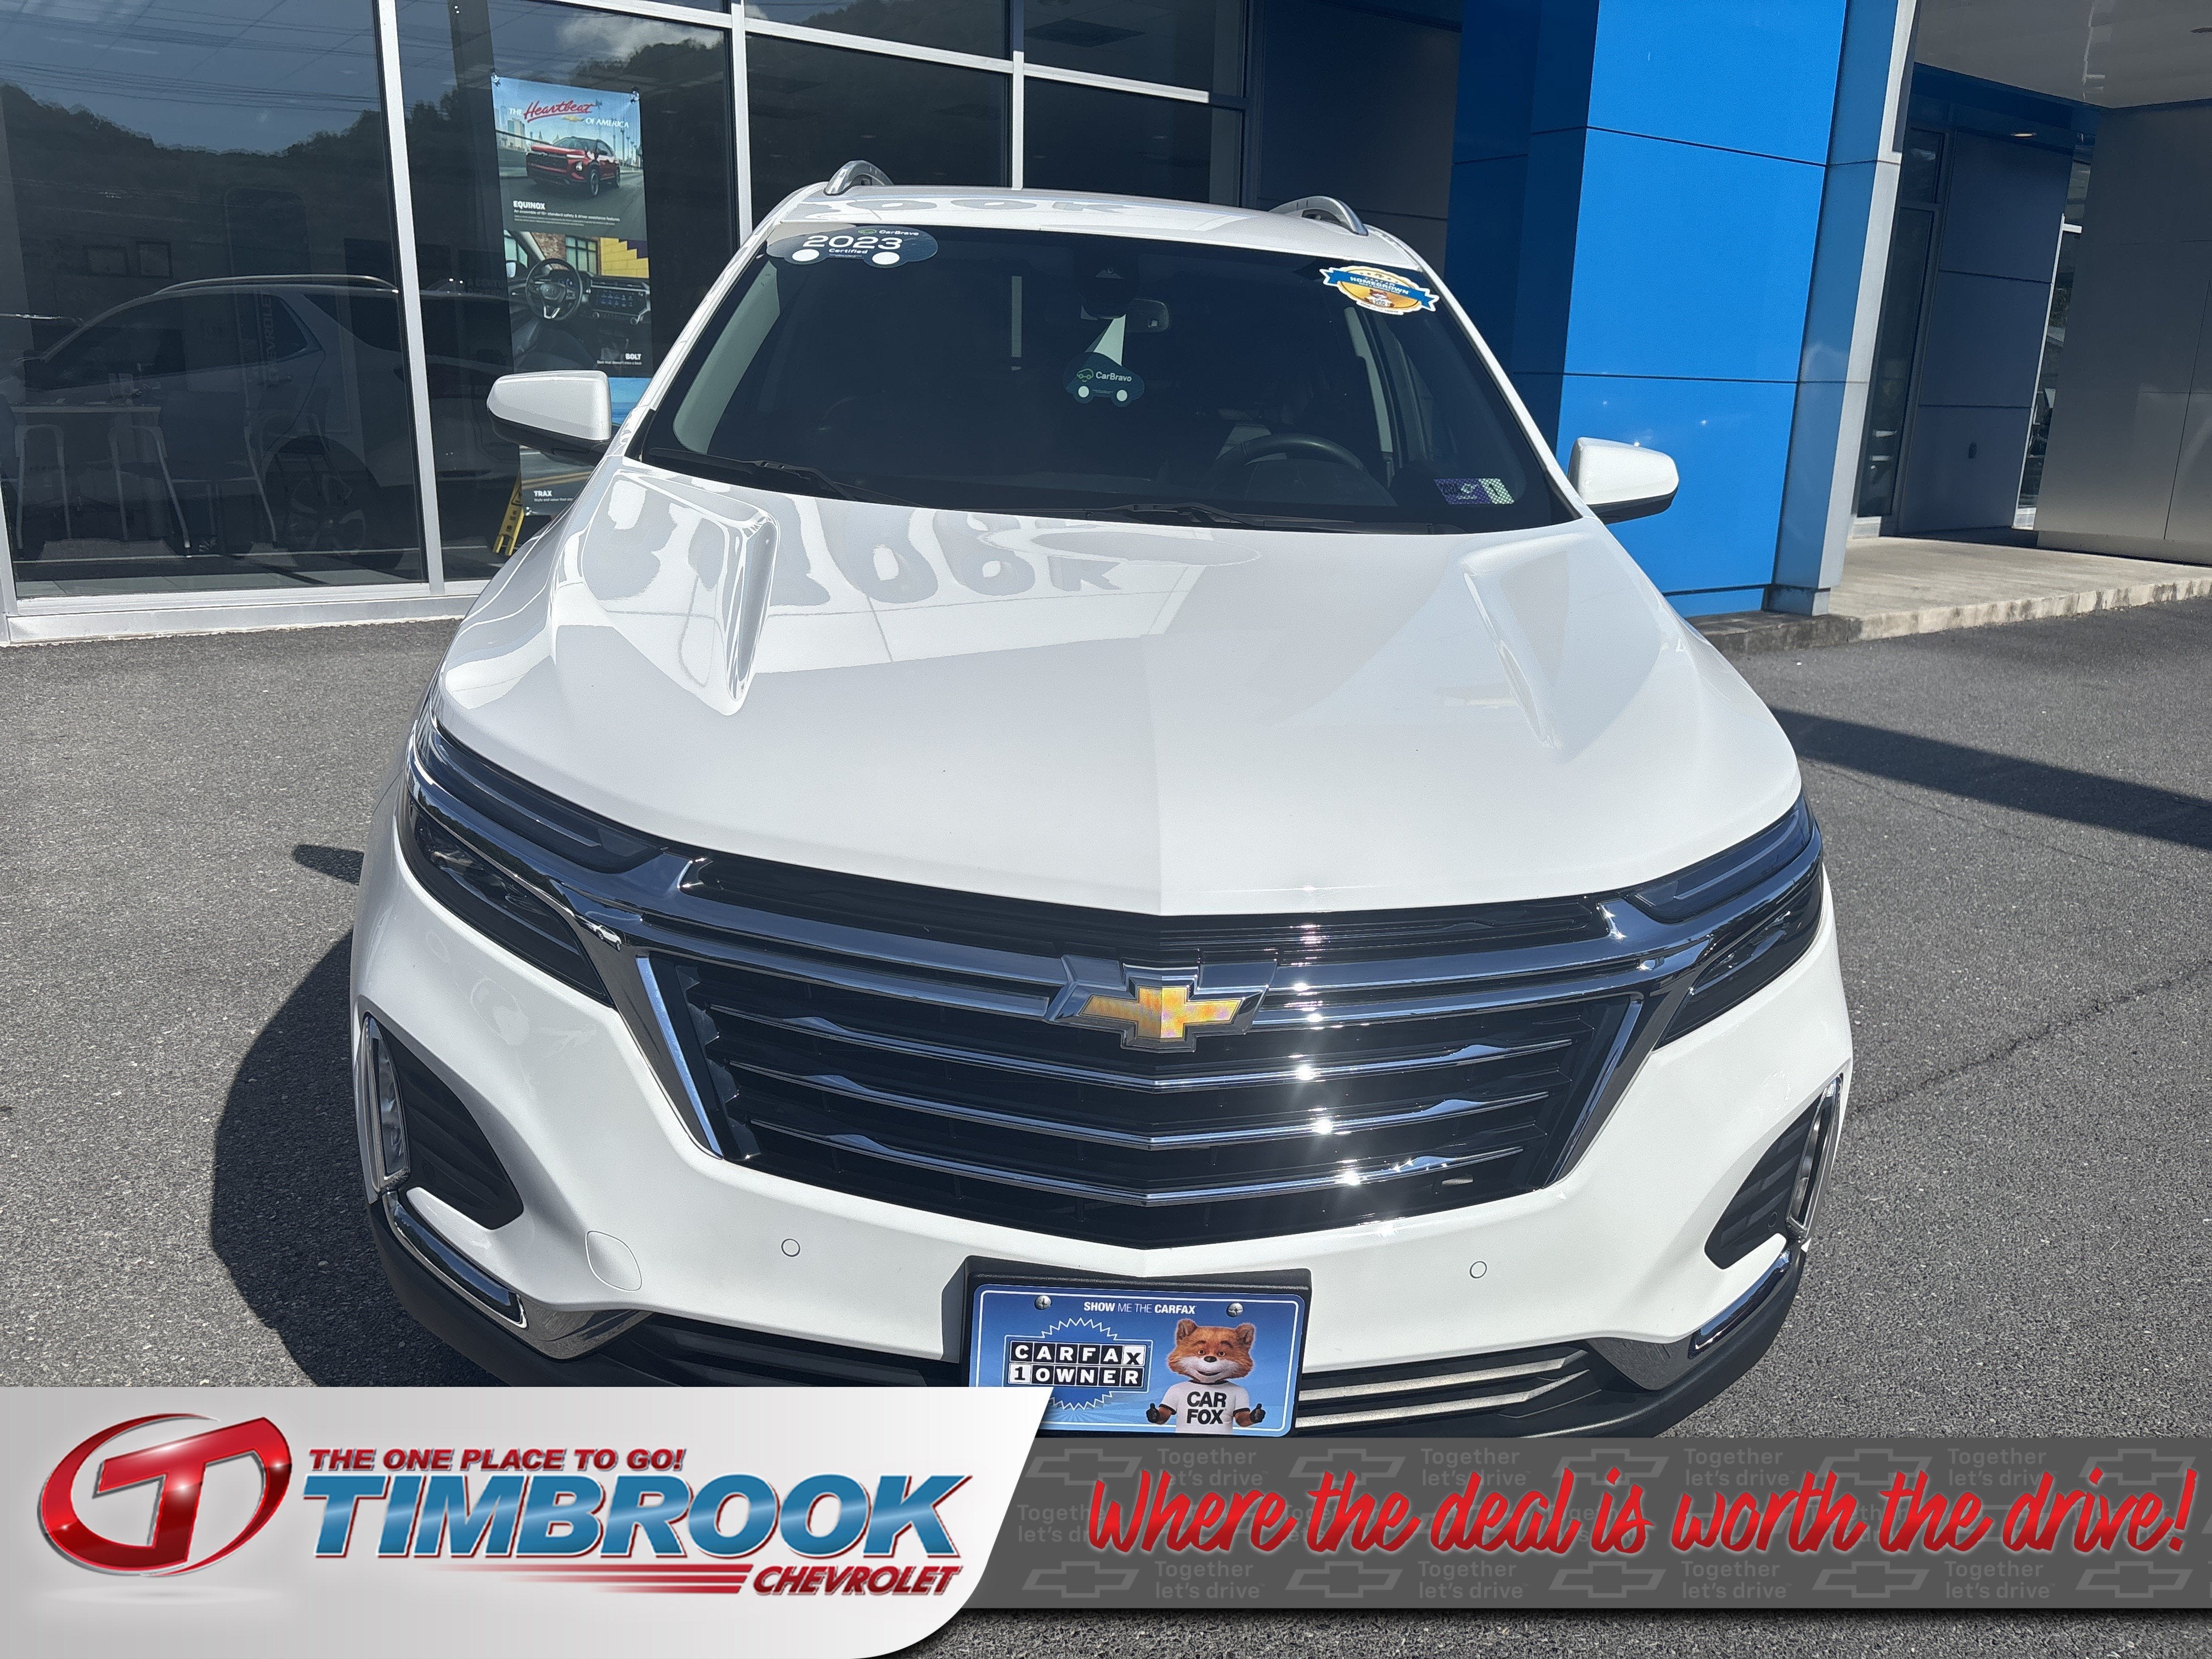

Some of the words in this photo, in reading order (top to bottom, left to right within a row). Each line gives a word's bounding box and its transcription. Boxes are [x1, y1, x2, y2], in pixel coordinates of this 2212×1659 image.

[509, 108, 522, 116] THE
[523, 99, 596, 123] Heartbeat
[596, 119, 630, 128] AMERICA
[513, 200, 546, 210] EQUINOX
[803, 235, 903, 250] 2023
[1350, 276, 1410, 295] HOMEGROWN
[1096, 371, 1132, 382] CarBravo
[1084, 1301, 1115, 1312] SHOW
[1118, 1302, 1132, 1312] ME
[1134, 1304, 1152, 1313] THE
[1154, 1304, 1197, 1314] CARFAX
[1014, 1345, 1144, 1365] CARFAX
[1187, 1391, 1227, 1408] CAR
[1186, 1408, 1224, 1425] FOX
